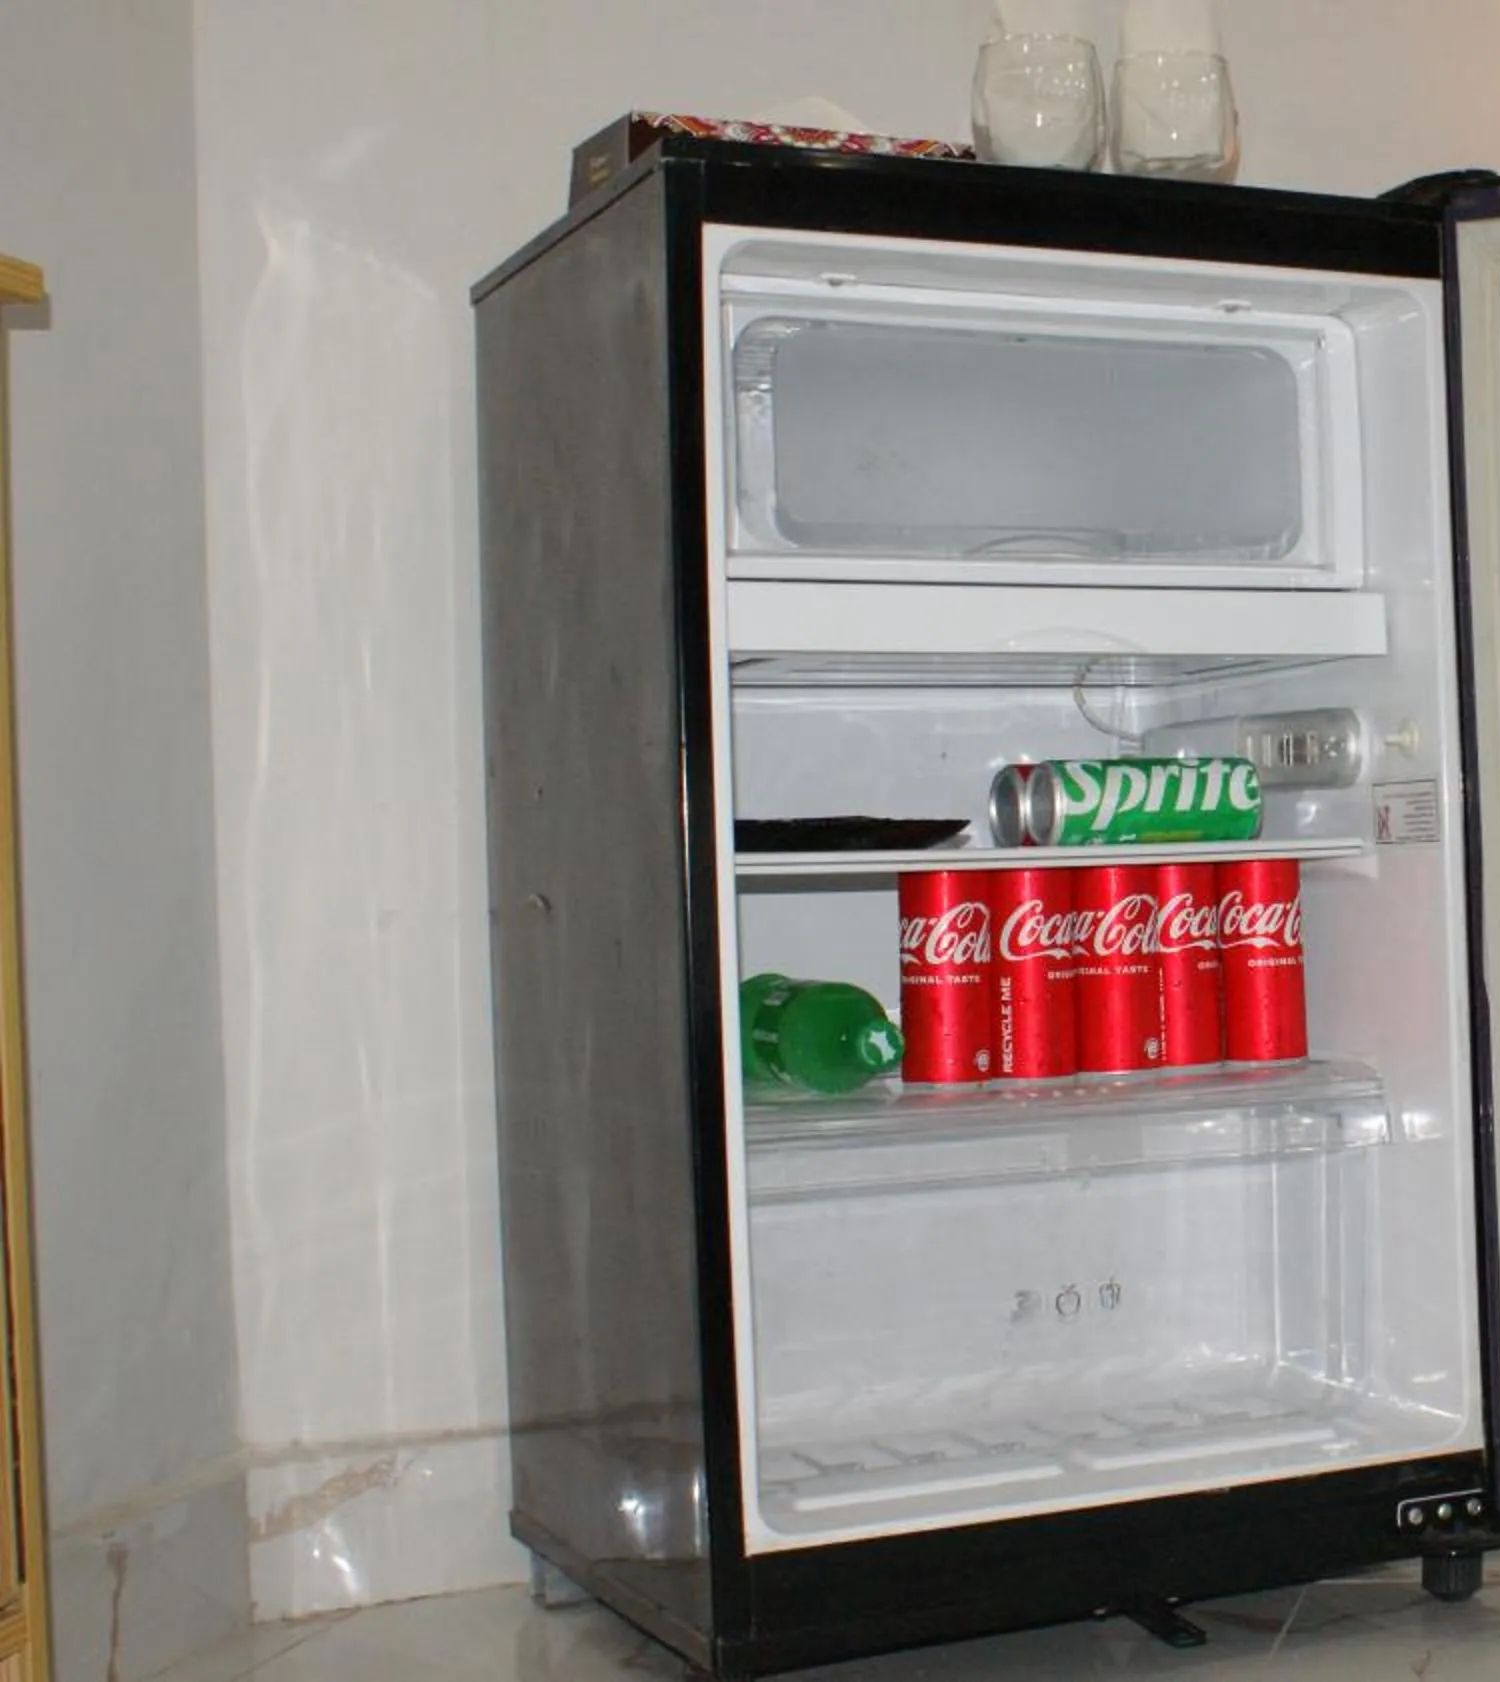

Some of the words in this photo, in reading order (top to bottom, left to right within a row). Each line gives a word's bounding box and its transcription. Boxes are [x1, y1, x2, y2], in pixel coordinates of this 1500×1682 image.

[1062, 756, 1262, 831] Sprite
[945, 974, 980, 985] TASTE
[1114, 965, 1149, 975] TASTE
[1000, 976, 1012, 1001] ME
[1001, 1003, 1013, 1073] RECYCLE
